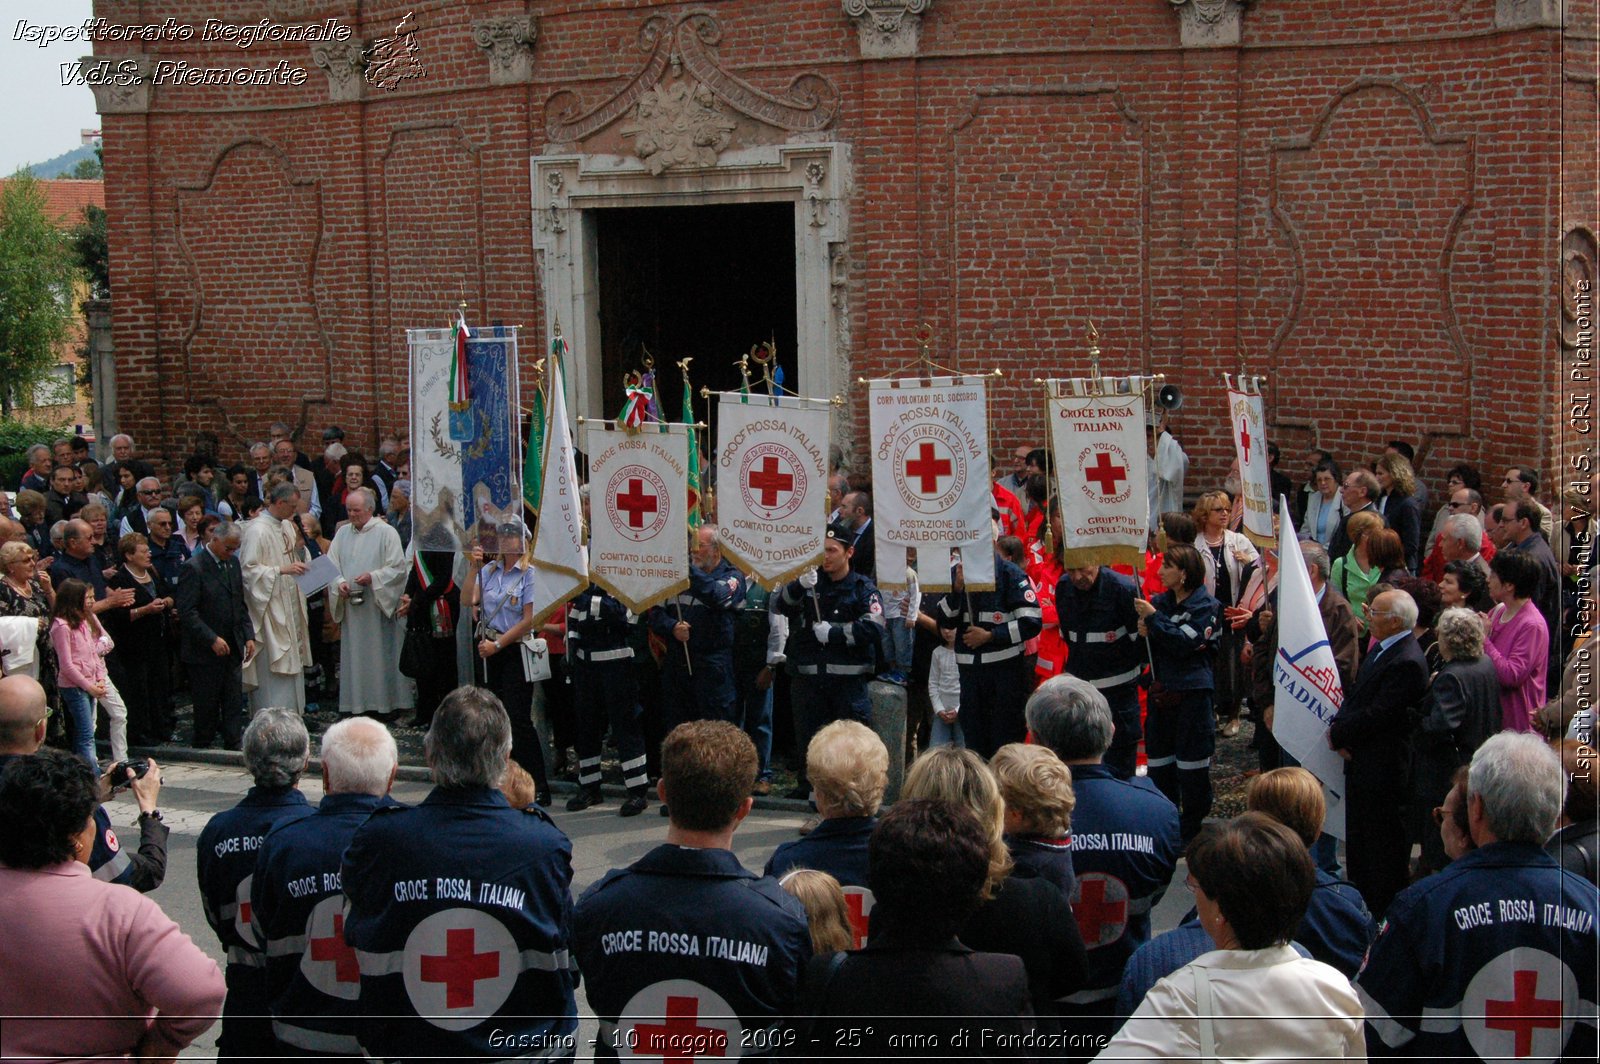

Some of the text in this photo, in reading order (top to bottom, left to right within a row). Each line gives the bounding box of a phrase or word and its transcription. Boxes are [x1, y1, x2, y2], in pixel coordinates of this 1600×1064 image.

[896, 394, 931, 405] VOLONTARI
[933, 394, 945, 403] DEL
[948, 392, 978, 402] SOCCORSO
[1060, 407, 1134, 419] CROCE ROSSA
[878, 407, 982, 461] CROCE ROSSA ITALIANA
[913, 426, 951, 442] GINEVRA
[1073, 421, 1124, 432] ITALIANA
[746, 419, 788, 436] ROSSA
[789, 425, 827, 478] ITALIANA
[759, 444, 788, 457] GINEVRA
[788, 453, 797, 464] 22
[591, 440, 685, 478] CROCE ROSSA ITALIANA
[558, 446, 568, 496] ROSSA
[624, 467, 652, 480] GINEVRA
[652, 475, 662, 485] 22
[1081, 485, 1096, 500] DEL
[733, 519, 814, 536] COMITATO LOCALE
[900, 519, 966, 529] POSTAZIONE DI
[1087, 515, 1137, 526] GRUPPO DI
[721, 527, 821, 561] GASSINO TORINESE
[764, 536, 772, 544] DI
[887, 530, 980, 541] CASALBORGONE
[600, 552, 673, 564] COMITATO LOCALE
[595, 565, 680, 579] SETTIMO TORINESE
[1071, 833, 1154, 854] ROSSA ITALIANA
[288, 875, 318, 898] CROCE
[394, 877, 526, 911] CROCE ROSSA ITALIANA
[1453, 899, 1594, 934] CROCE ROSSA ITALIANA
[601, 930, 769, 967] CROCE ROSSA ITALIANA
